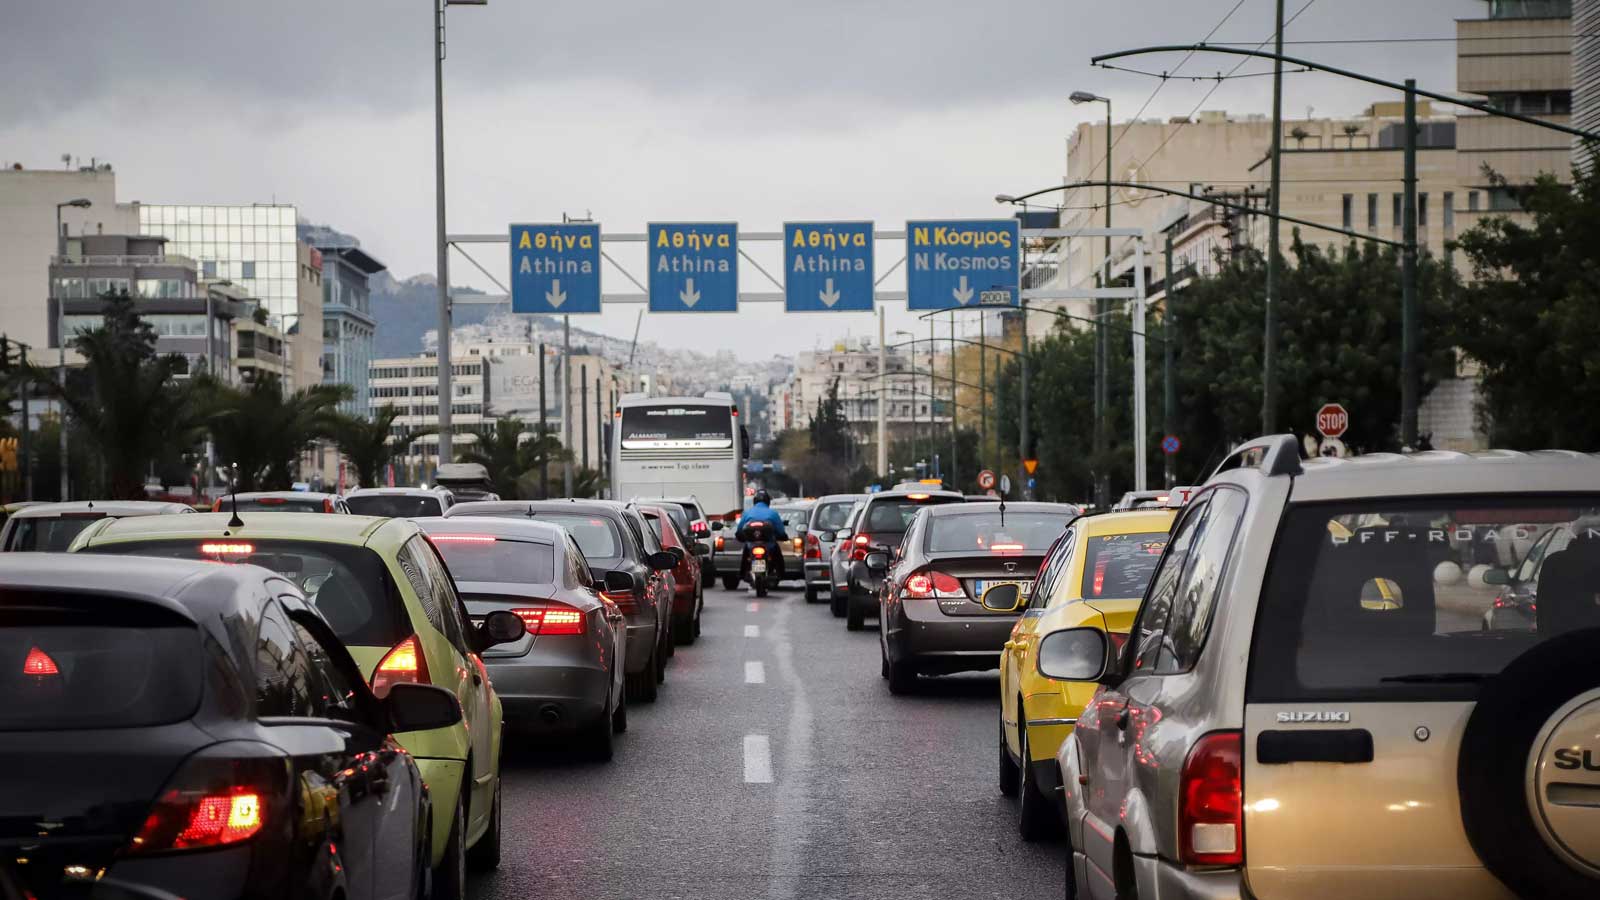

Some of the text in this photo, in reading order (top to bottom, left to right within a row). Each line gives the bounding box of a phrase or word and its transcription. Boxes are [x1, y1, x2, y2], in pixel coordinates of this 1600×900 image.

[518, 229, 593, 253] Αθήνα
[656, 228, 730, 252] Αθήνα
[792, 227, 866, 250] Αθήνα
[933, 227, 1012, 249] Κόσμος
[519, 255, 593, 274] Athina
[656, 253, 730, 273] Athina
[792, 253, 866, 272] Athina
[934, 252, 1012, 271] Kosmos
[1319, 413, 1345, 430] STOP
[1277, 711, 1351, 723] SUZUKI
